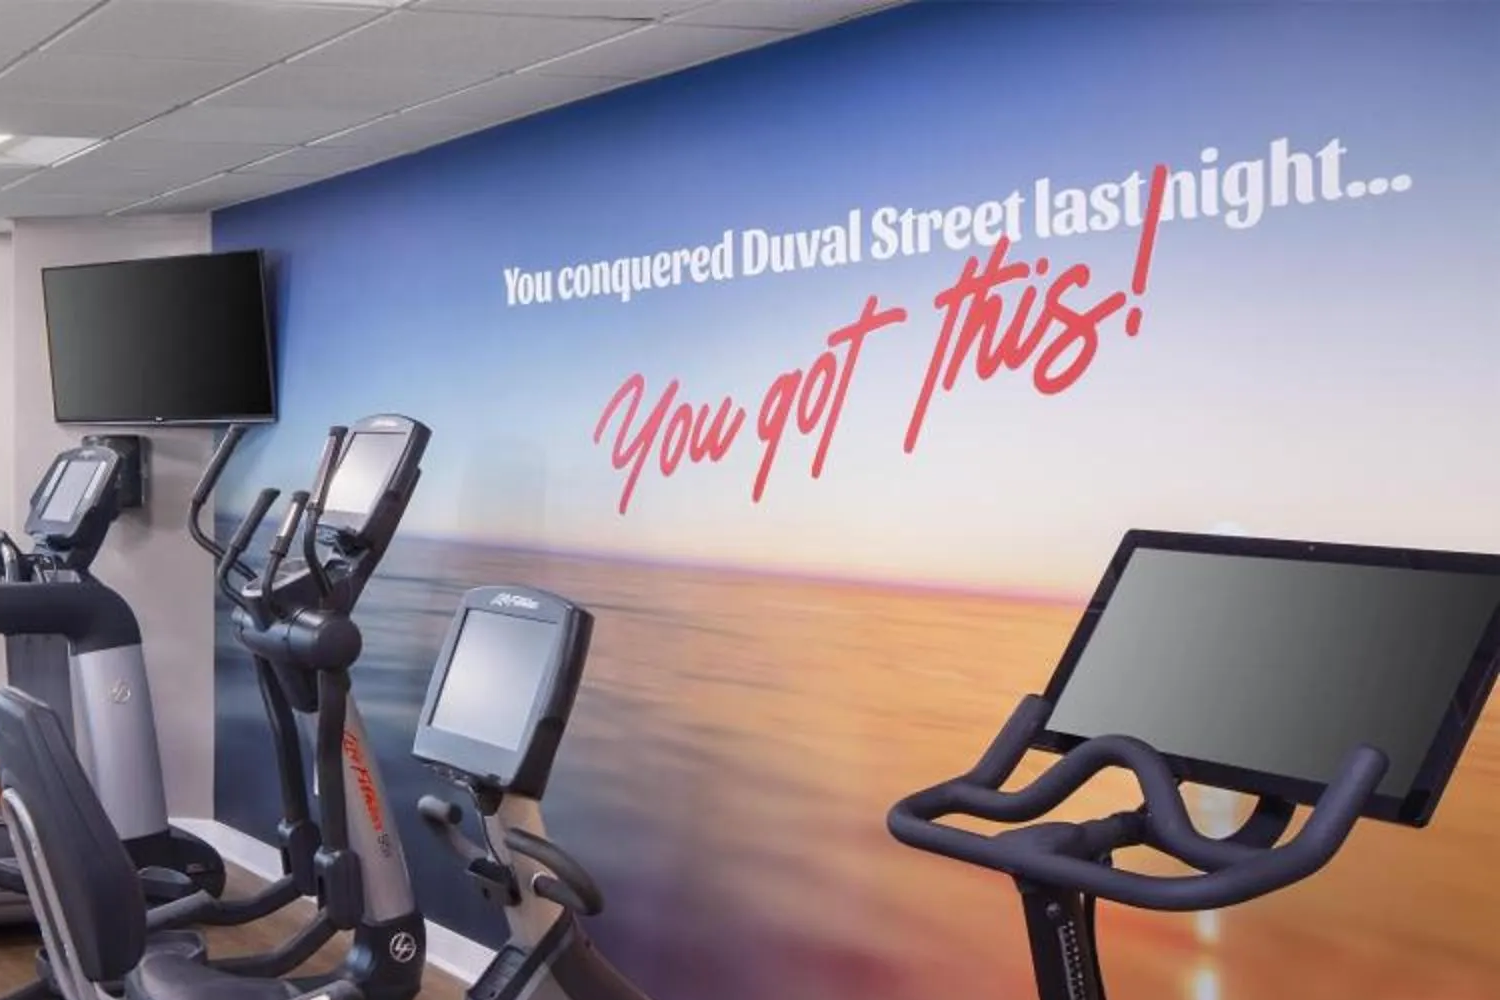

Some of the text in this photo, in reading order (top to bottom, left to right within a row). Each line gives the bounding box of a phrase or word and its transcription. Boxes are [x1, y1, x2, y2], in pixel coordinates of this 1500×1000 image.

[504, 268, 552, 306] You
[557, 230, 734, 303] conquered
[741, 208, 862, 277] Duval
[870, 189, 1026, 261] Street
[1034, 169, 1146, 238] last
[593, 163, 1168, 515] You got this!
